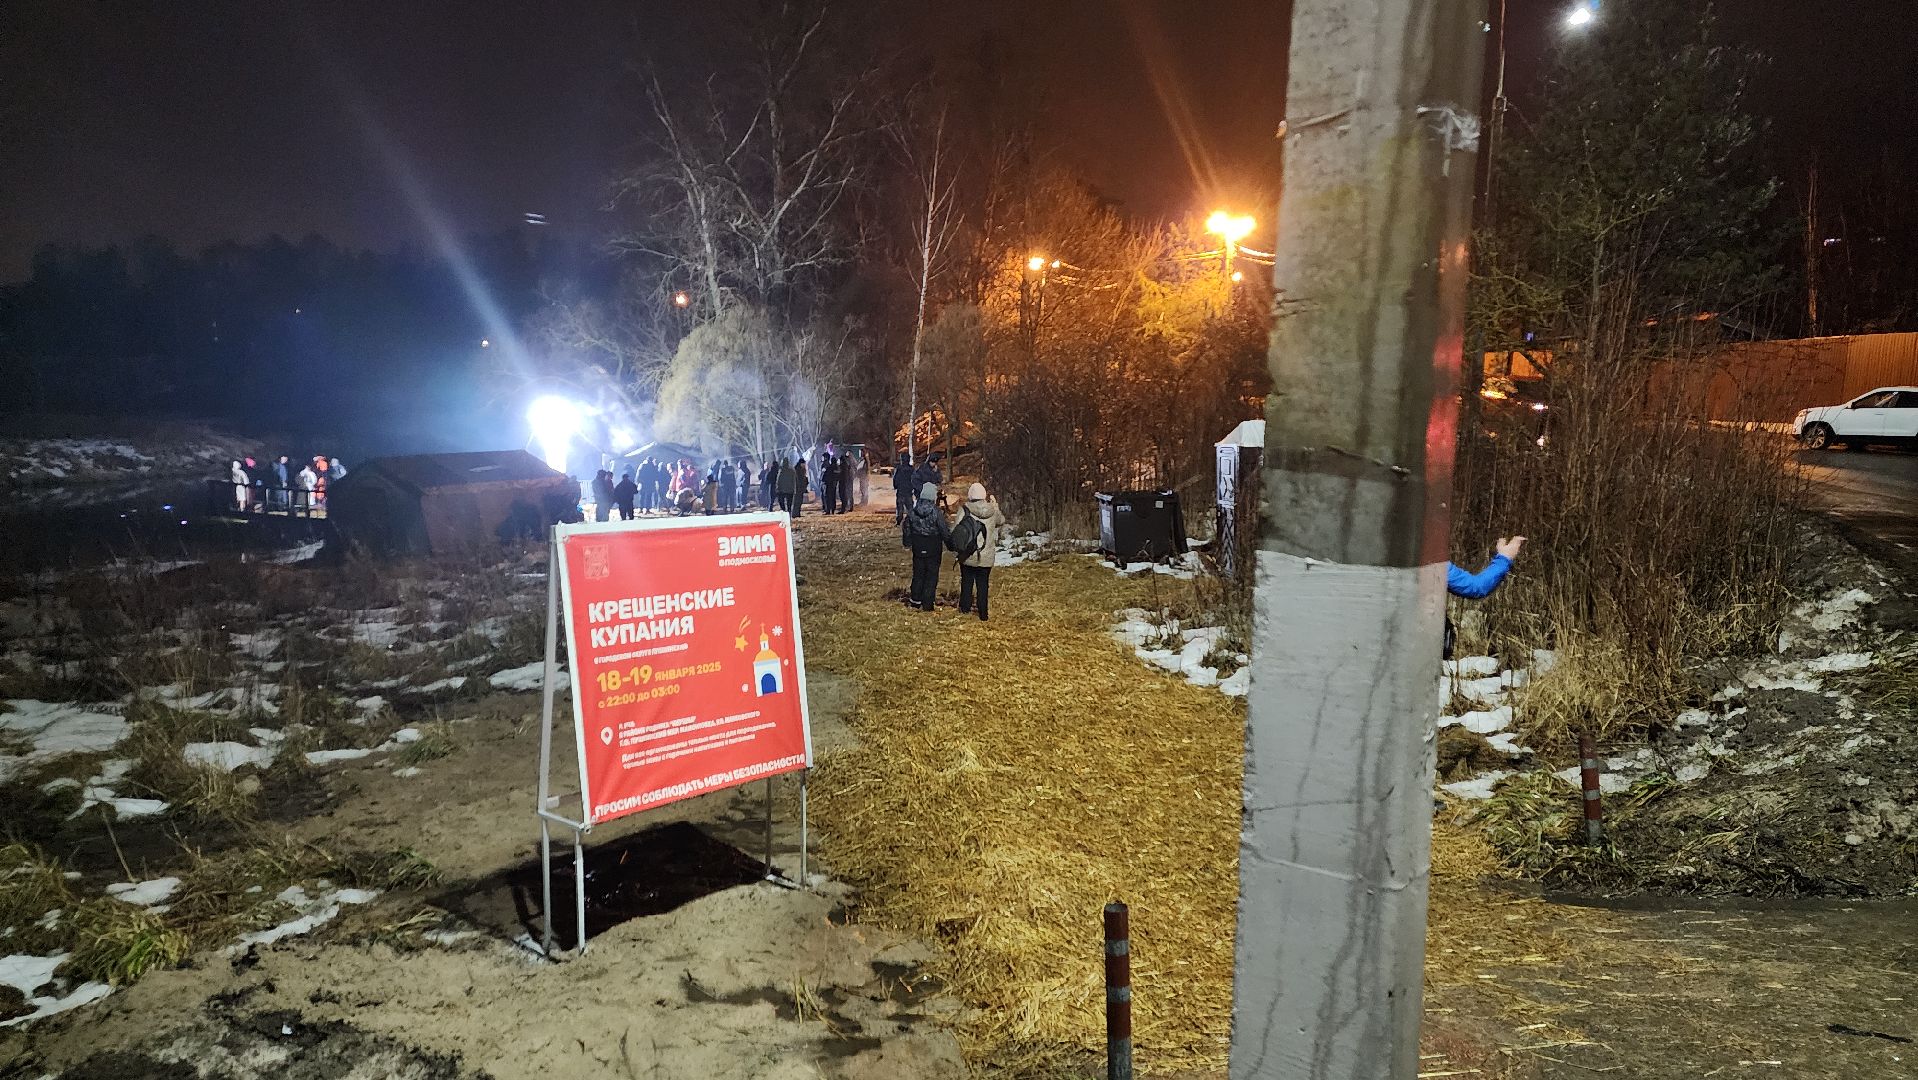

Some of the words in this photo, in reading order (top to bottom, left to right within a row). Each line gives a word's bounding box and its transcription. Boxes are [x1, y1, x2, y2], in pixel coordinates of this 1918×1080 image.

[718, 534, 775, 556] ЗИМА
[588, 586, 736, 623] КРЕЩЕНСКИЕ
[590, 615, 694, 648] КУПАНИЯ
[596, 664, 652, 692] 18-19
[654, 666, 696, 682] ЯНВАРЯ
[696, 661, 722, 675] 2025
[606, 692, 635, 708] 22:00
[637, 691, 650, 703] до
[651, 684, 680, 698] 03:00
[595, 795, 641, 817] ПРОСИМ
[641, 779, 704, 804] СОБЛЮДАТЬ
[703, 771, 733, 787] МЕРЫ
[733, 754, 805, 780] БЕЗОПАСНОСТИ
